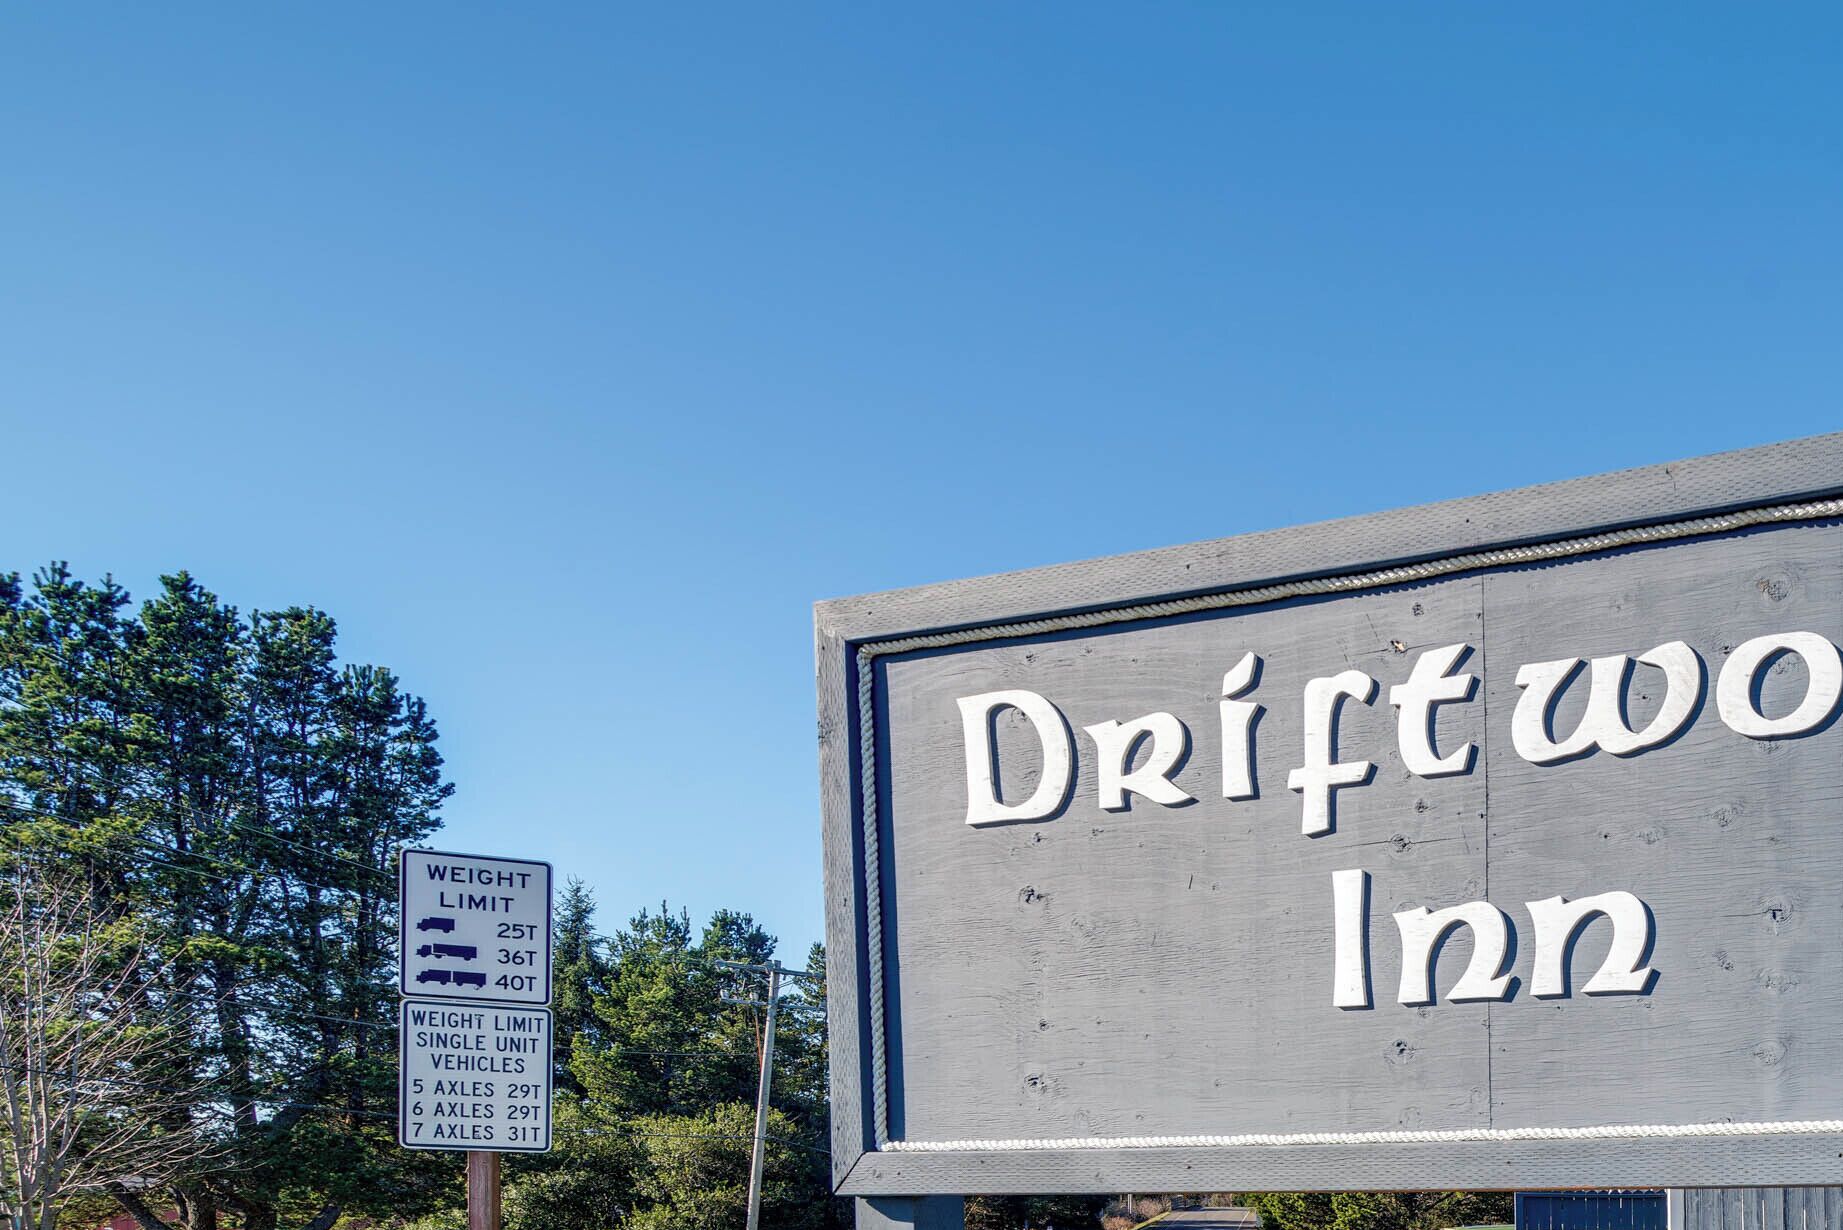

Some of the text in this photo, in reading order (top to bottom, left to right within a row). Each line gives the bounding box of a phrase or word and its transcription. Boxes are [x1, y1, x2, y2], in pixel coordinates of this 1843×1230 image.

[427, 864, 531, 888] WEIGHT
[440, 892, 515, 912] LIMIT
[497, 923, 537, 940] 25T
[1332, 868, 1652, 1007] Inn
[497, 949, 537, 966] 36T
[495, 975, 537, 992] 40T
[412, 1010, 544, 1033] WEIGHT LIMIT
[416, 1032, 539, 1053] SINGLE UNIT
[431, 1054, 525, 1073] VEHICLES
[413, 1079, 541, 1099] 5 AXLES 29T
[413, 1102, 541, 1120] 6 AXLES 29T
[413, 1123, 541, 1142] 7 AXLES 31T
